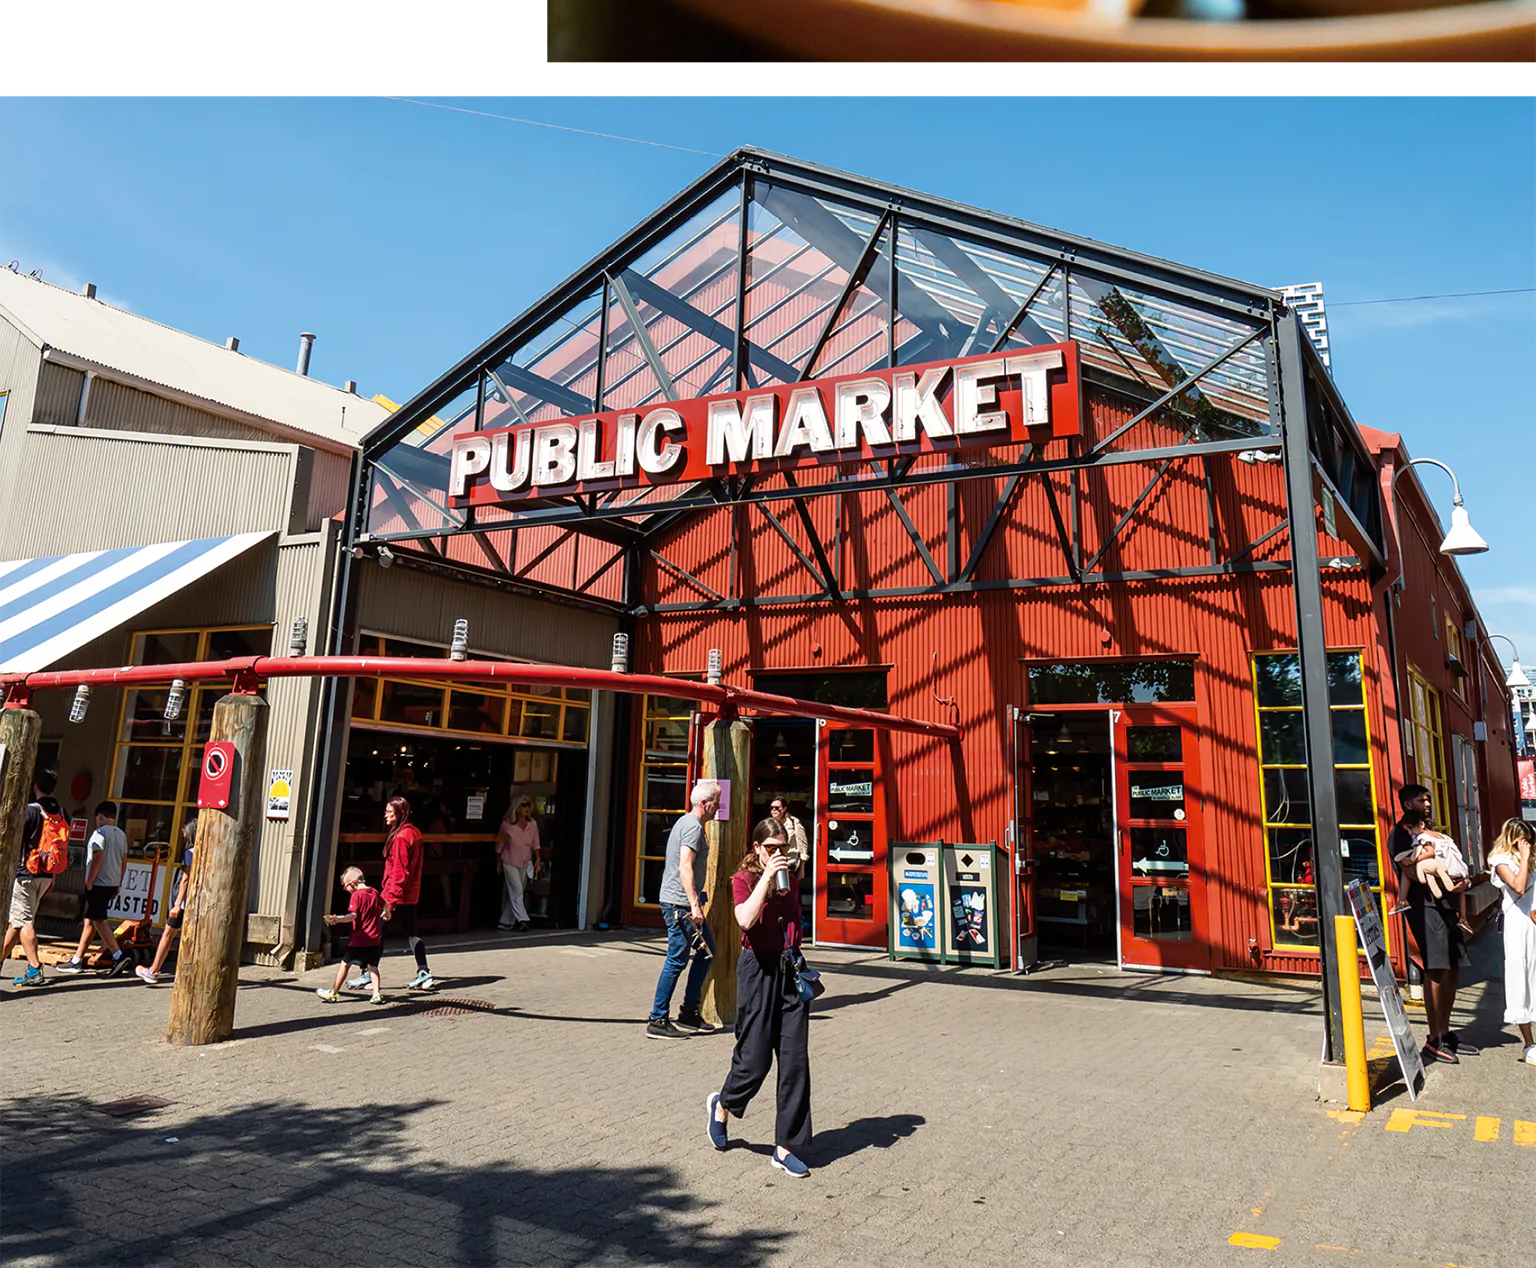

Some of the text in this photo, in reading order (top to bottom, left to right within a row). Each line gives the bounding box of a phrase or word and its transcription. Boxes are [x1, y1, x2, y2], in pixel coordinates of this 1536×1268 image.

[448, 349, 1064, 498] PUBLIC MARKET
[1113, 712, 1121, 723] 7
[845, 783, 871, 792] MARKET
[1132, 786, 1181, 797] PUBLIC MARKET
